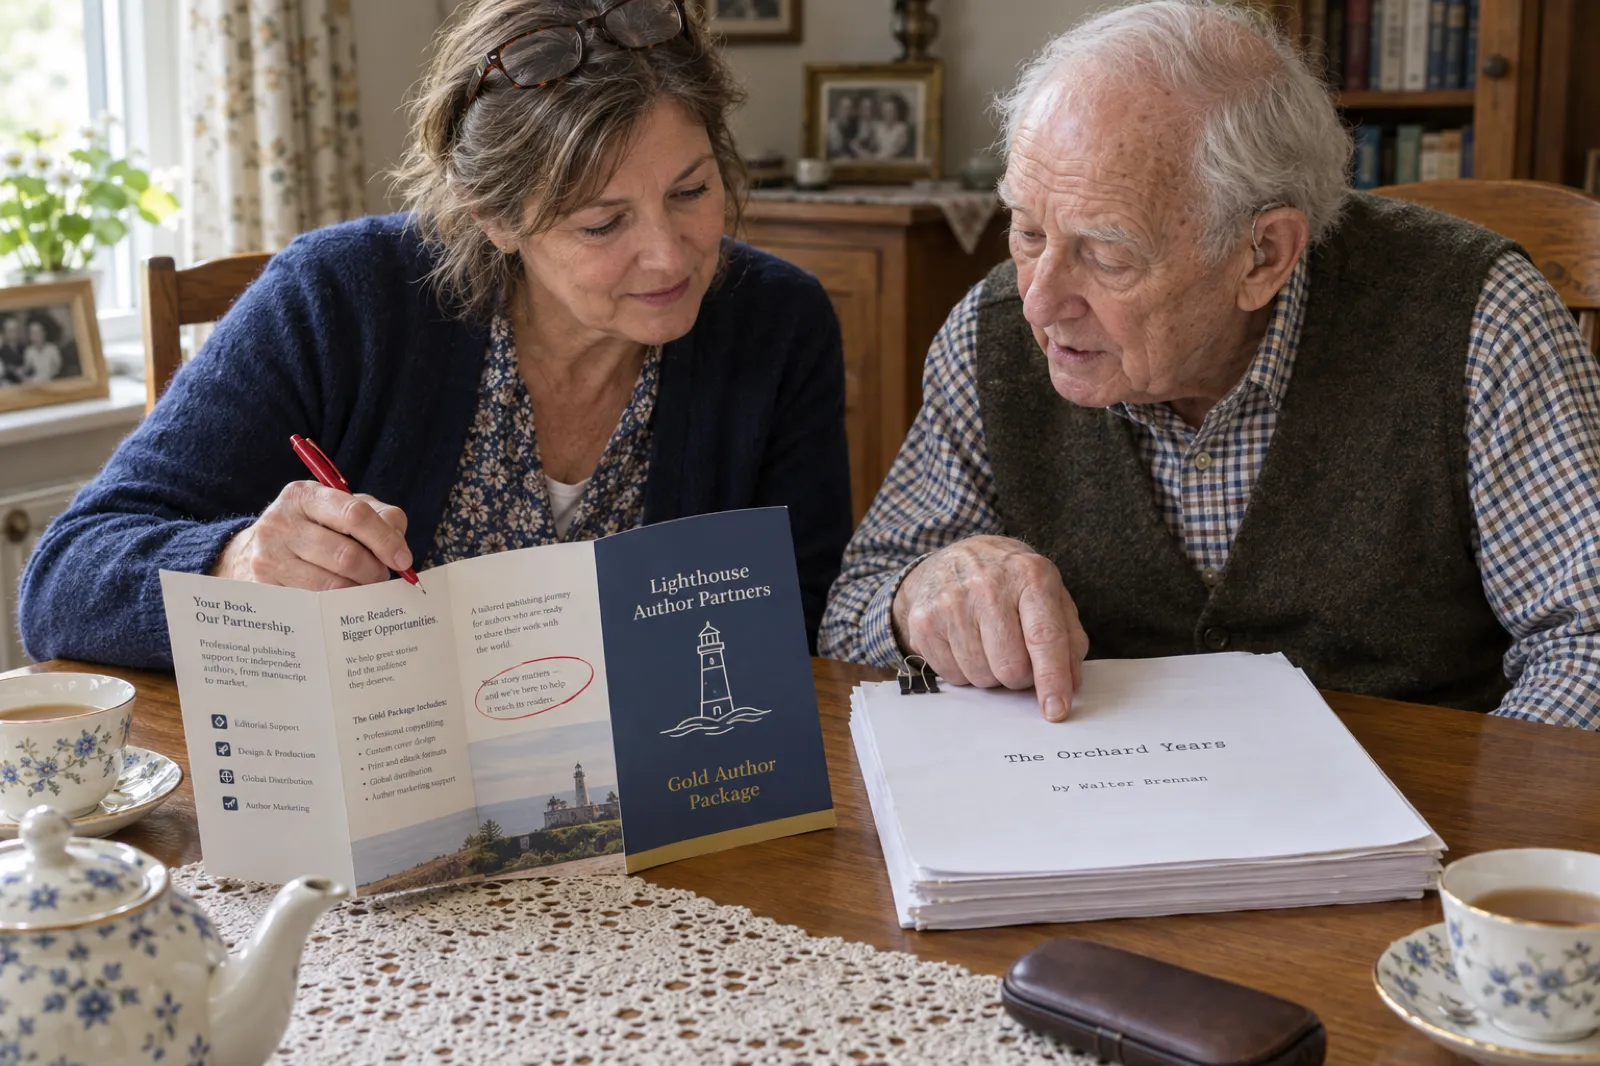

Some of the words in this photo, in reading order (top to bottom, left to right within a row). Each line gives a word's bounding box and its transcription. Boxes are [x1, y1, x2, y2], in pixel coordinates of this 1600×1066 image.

[650, 566, 750, 595] Lighthouse
[193, 596, 220, 608] Your
[224, 601, 256, 613] Book.
[478, 603, 504, 613] tailored
[507, 596, 543, 609] publishing
[544, 591, 571, 603] journey
[633, 598, 694, 621] Author
[699, 585, 771, 608] Partners
[196, 612, 219, 624] Our
[223, 615, 294, 635] Partnership.
[340, 615, 364, 626] More
[367, 608, 406, 621] Readers.
[472, 620, 482, 628] for
[485, 615, 511, 625] authors
[543, 606, 563, 614] ready
[342, 629, 372, 642] Bigger
[375, 615, 438, 636] Opportunities.
[484, 630, 502, 639] share
[523, 623, 541, 632] work
[543, 619, 558, 627] with
[200, 639, 250, 652] Professional
[253, 647, 295, 658] publishing
[376, 651, 394, 660] great
[396, 646, 418, 655] stories
[476, 646, 488, 654] the
[202, 654, 233, 662] support
[251, 658, 301, 669] independent
[204, 665, 237, 675] authors,
[240, 668, 259, 676] from
[261, 671, 306, 682] manuscript
[347, 669, 361, 677] find
[501, 675, 519, 684] story
[522, 670, 550, 681] matters
[216, 678, 247, 687] market.
[349, 681, 364, 689] they
[485, 691, 499, 700] and
[549, 680, 566, 688] help
[353, 716, 367, 724] The
[369, 712, 385, 721] Gold
[388, 706, 415, 717] Package
[417, 700, 447, 711] Includes:
[487, 705, 492, 713] it
[495, 702, 515, 711] reach
[234, 720, 267, 729] Editorial
[270, 723, 299, 731] Support
[364, 727, 403, 741] Professional
[238, 748, 264, 757] Design
[275, 750, 315, 759] Production
[366, 746, 392, 756] Custom
[394, 741, 412, 750] cover
[415, 736, 436, 745] design
[1004, 754, 1045, 763] The
[1057, 744, 1149, 760] Orchard
[1160, 740, 1226, 752] Years
[368, 762, 384, 771] Print
[386, 758, 398, 767] and
[422, 749, 446, 758] formats
[242, 775, 266, 783] Global
[269, 777, 313, 785] Distribution
[370, 775, 392, 785] Global
[668, 768, 709, 792] Gold
[715, 760, 776, 782] Author
[1079, 780, 1135, 790] Walter
[1144, 775, 1208, 785] Brennan
[372, 790, 395, 800] Author
[397, 783, 430, 794] marketing
[431, 776, 456, 788] support
[690, 785, 760, 810] Package
[273, 804, 310, 813] Marketing
